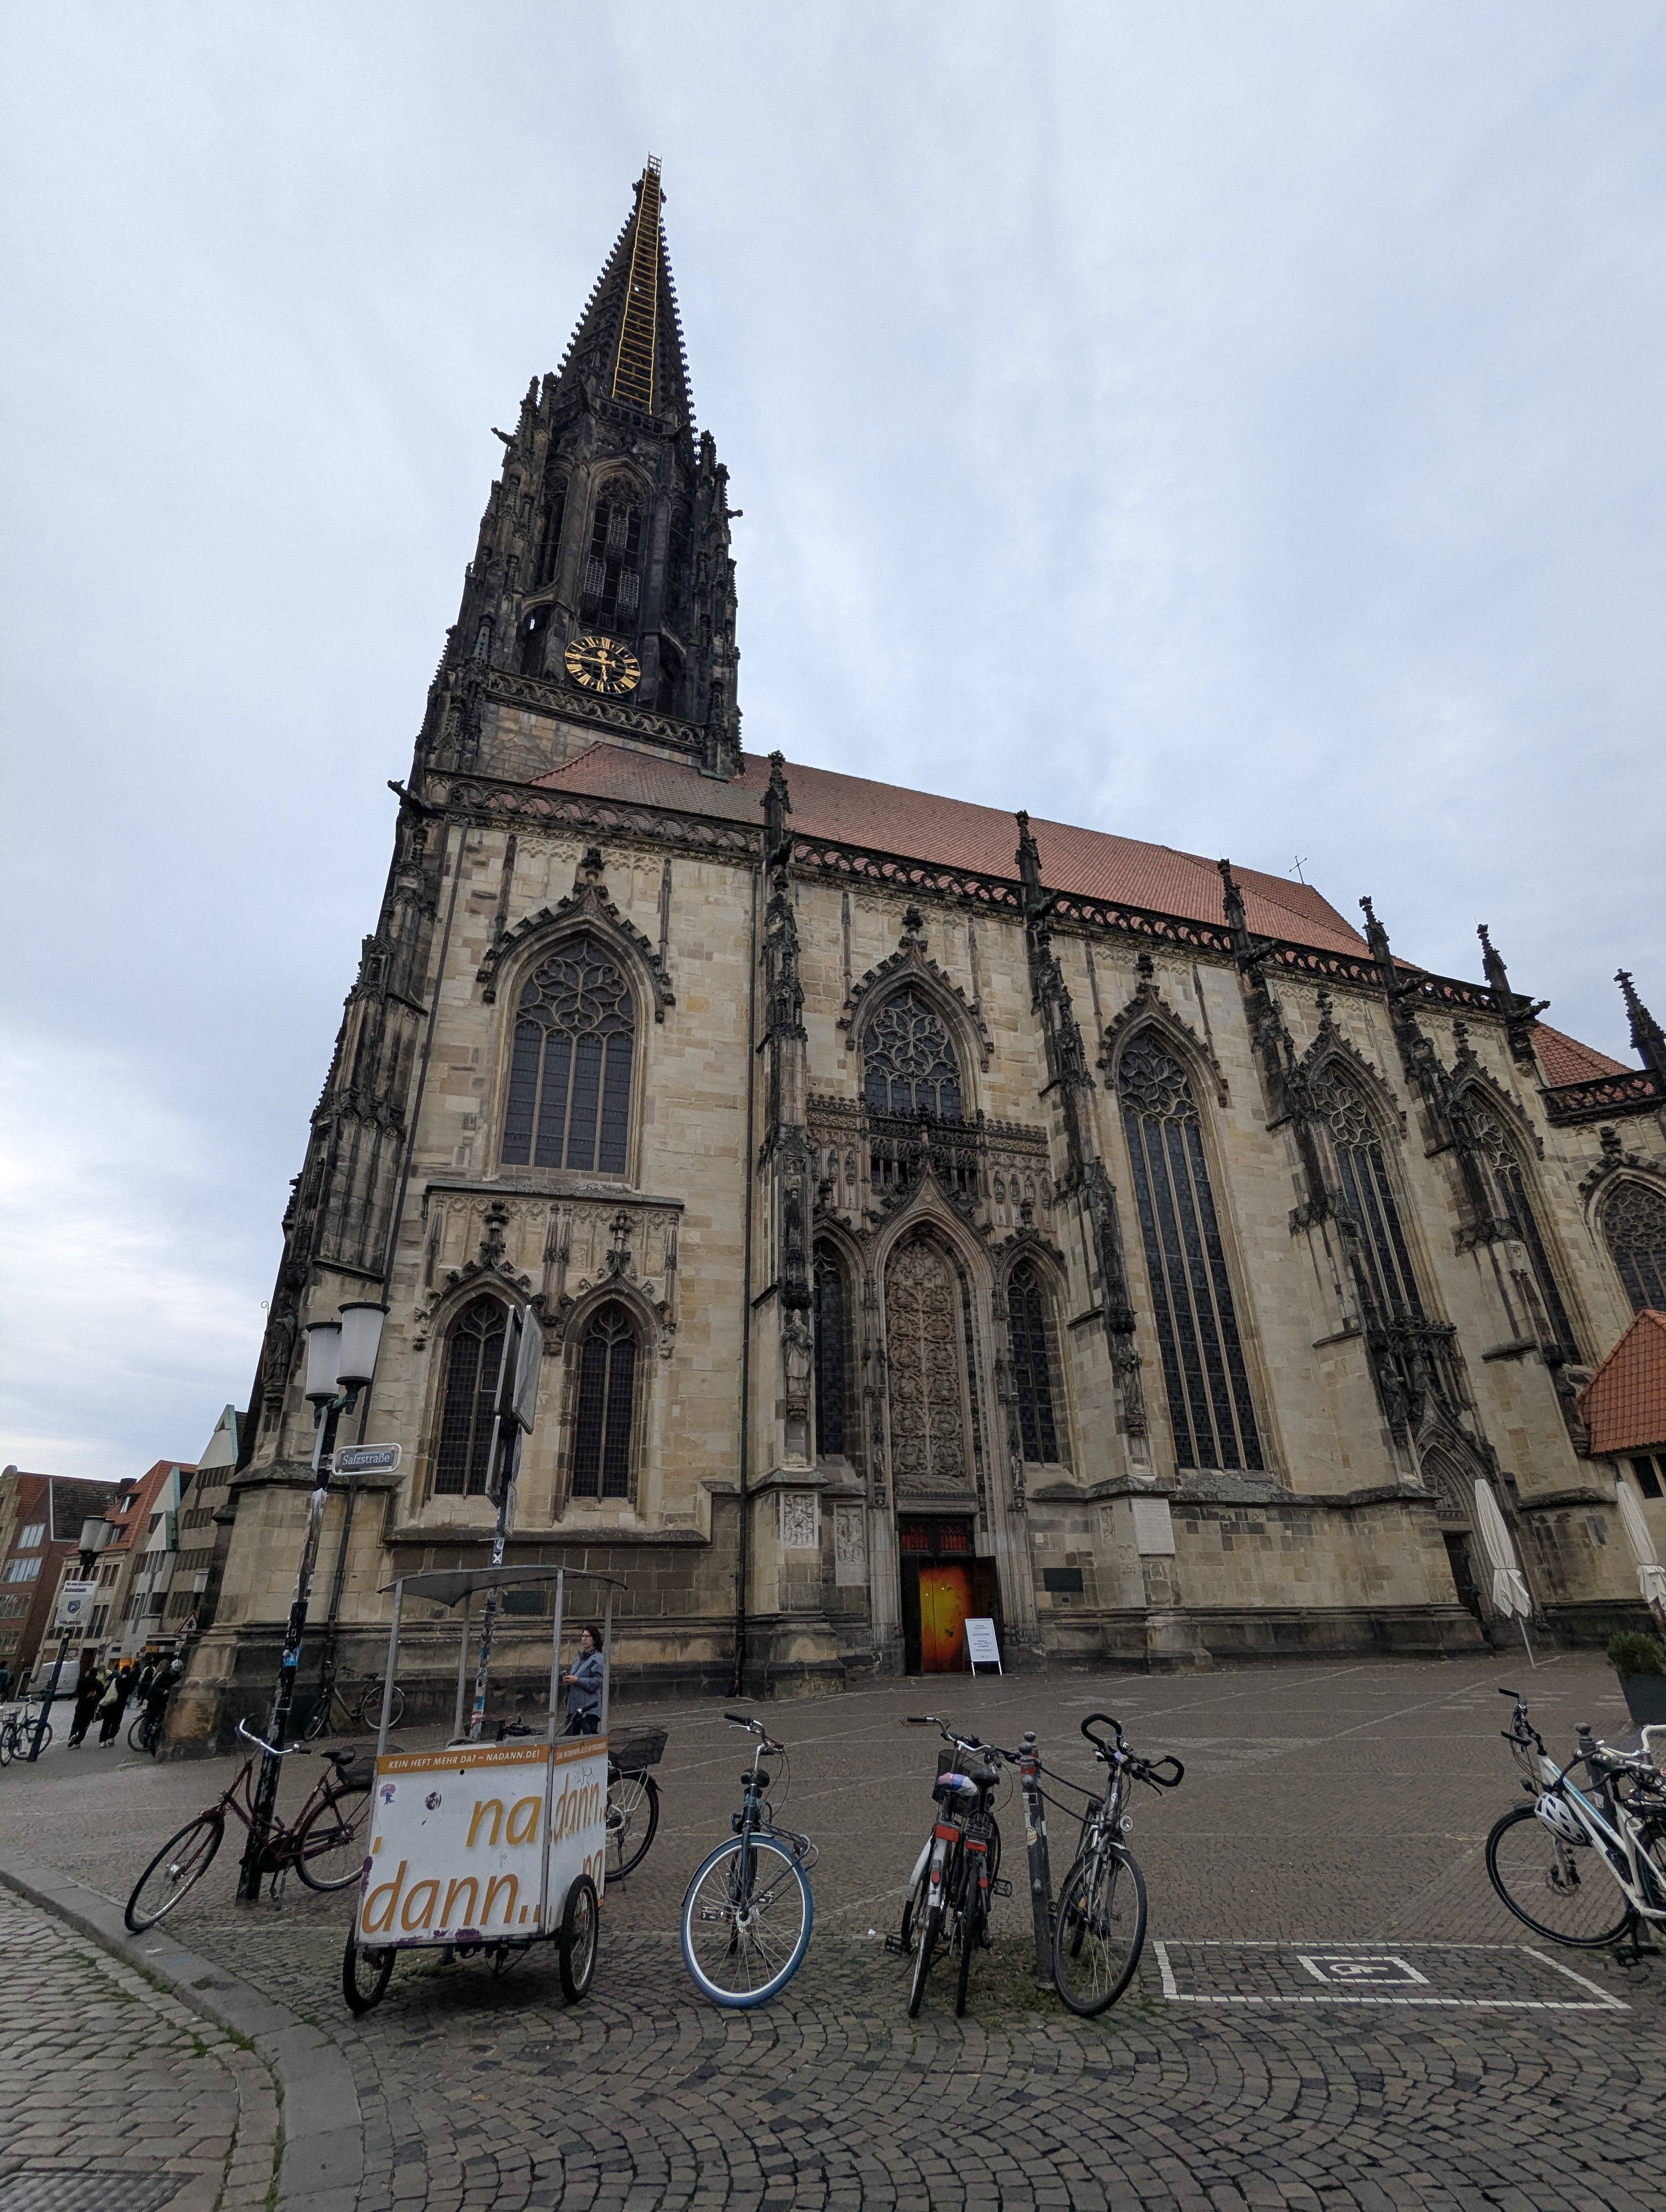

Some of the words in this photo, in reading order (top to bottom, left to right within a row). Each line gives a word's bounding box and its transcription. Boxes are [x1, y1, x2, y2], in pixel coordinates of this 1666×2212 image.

[342, 1452, 390, 1465] Salzstraße
[388, 1759, 408, 1769] KEIN
[411, 1758, 432, 1767] HEFT
[433, 1756, 458, 1765] MEHR
[460, 1754, 477, 1763] DA?
[486, 1750, 540, 1761] NADANN.DE!
[466, 1796, 542, 1848] na
